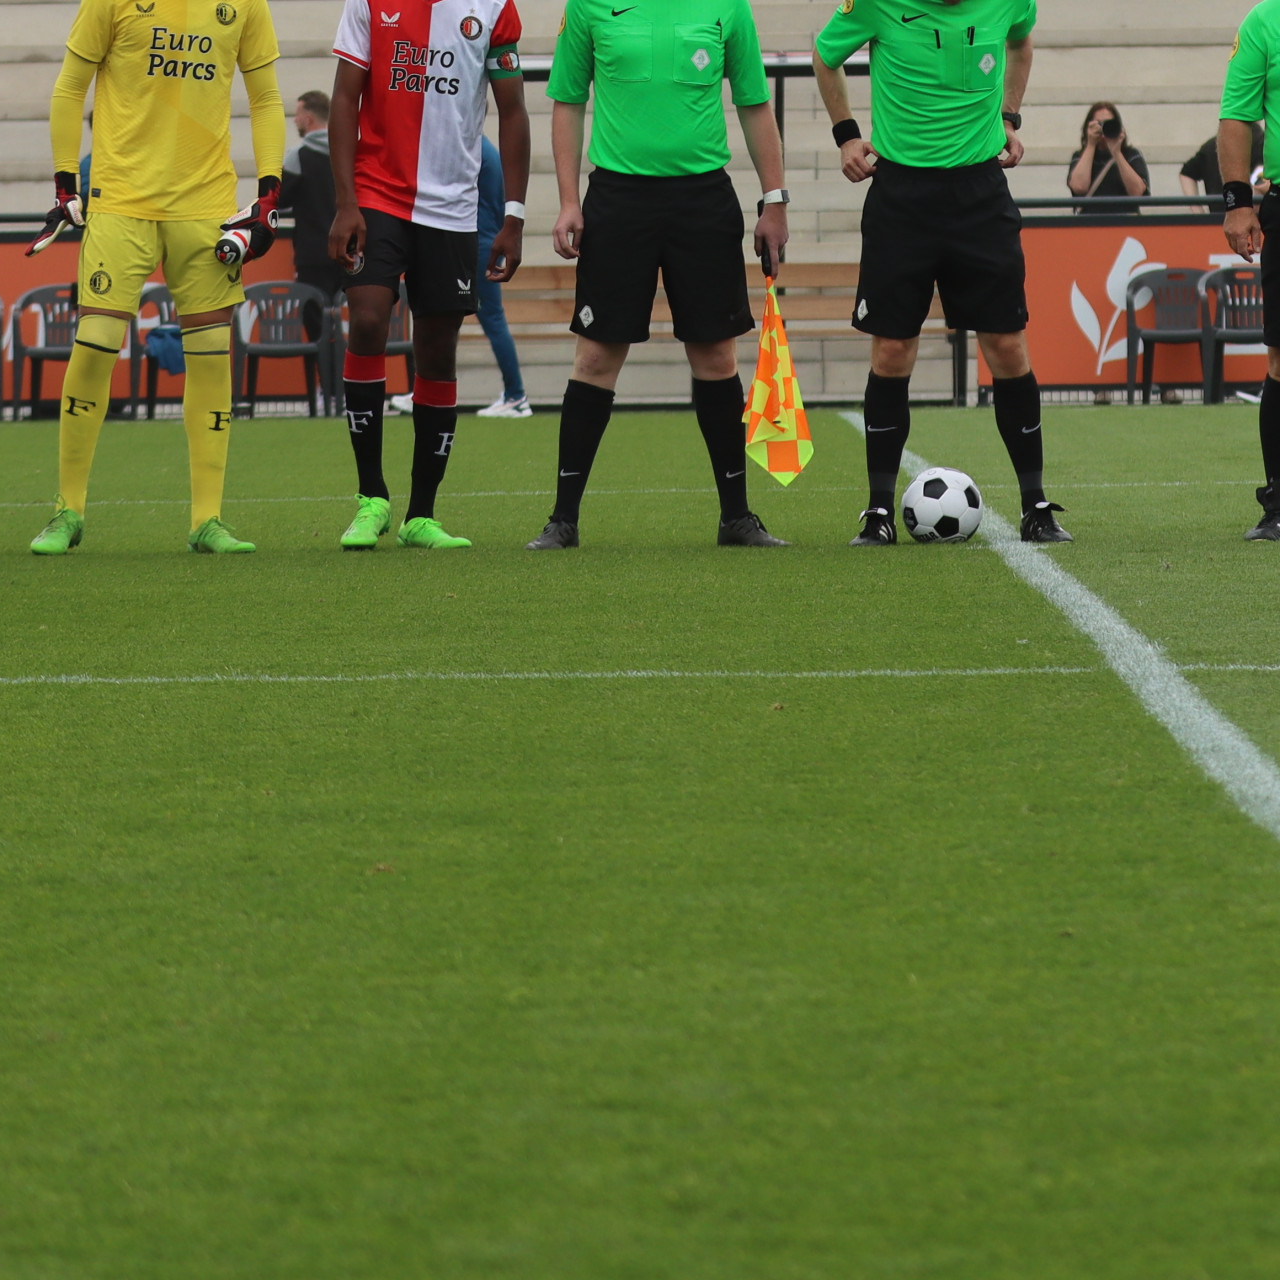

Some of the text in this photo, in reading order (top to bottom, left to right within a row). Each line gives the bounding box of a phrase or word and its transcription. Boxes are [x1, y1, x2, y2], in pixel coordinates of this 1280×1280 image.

[150, 27, 212, 54] Euro
[147, 53, 216, 81] Parcs
[392, 41, 455, 69] Euro
[389, 67, 460, 95] Parcs
[65, 395, 96, 417] F
[209, 410, 231, 431] F
[346, 410, 373, 433] F
